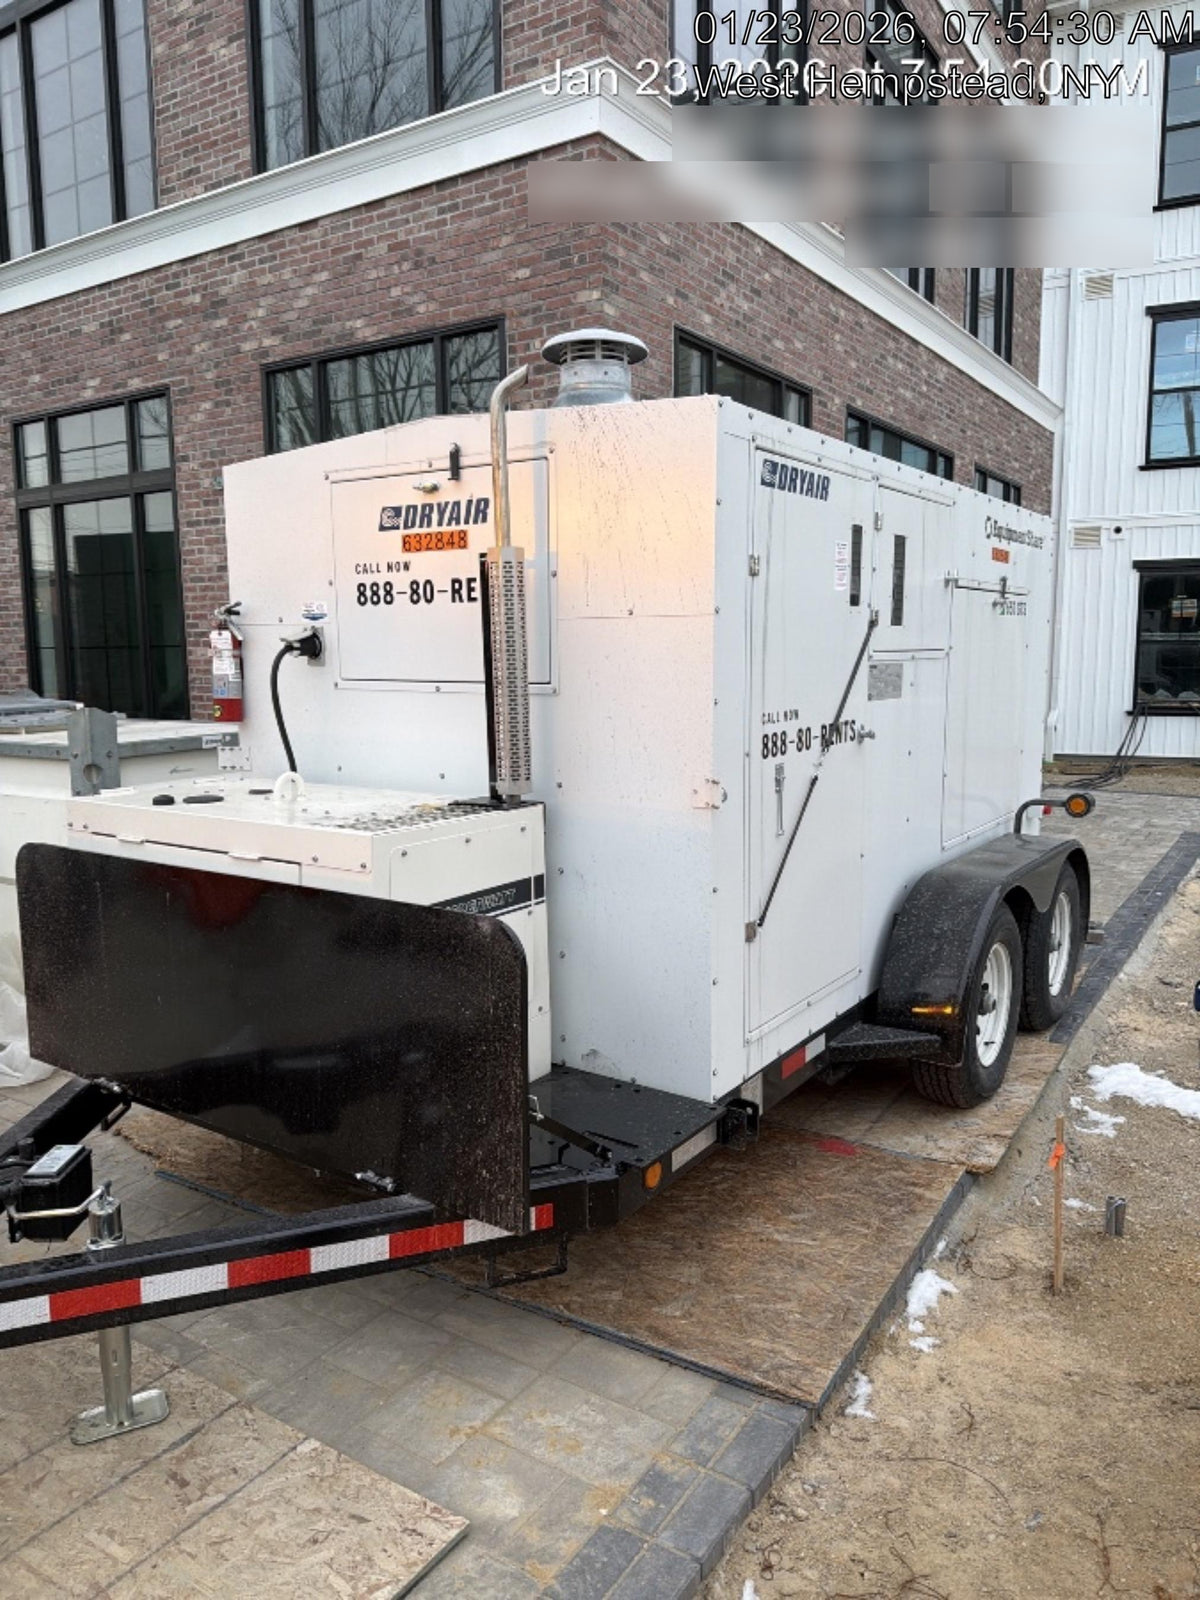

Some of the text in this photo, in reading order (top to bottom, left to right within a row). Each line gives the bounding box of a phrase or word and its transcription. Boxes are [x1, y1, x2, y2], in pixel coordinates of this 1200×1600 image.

[777, 463, 831, 502] DRYAIR
[402, 497, 490, 530] DRYAIR
[402, 530, 468, 552] 632848
[354, 560, 411, 575] CALL NOW
[356, 577, 478, 607] 888-80-RE
